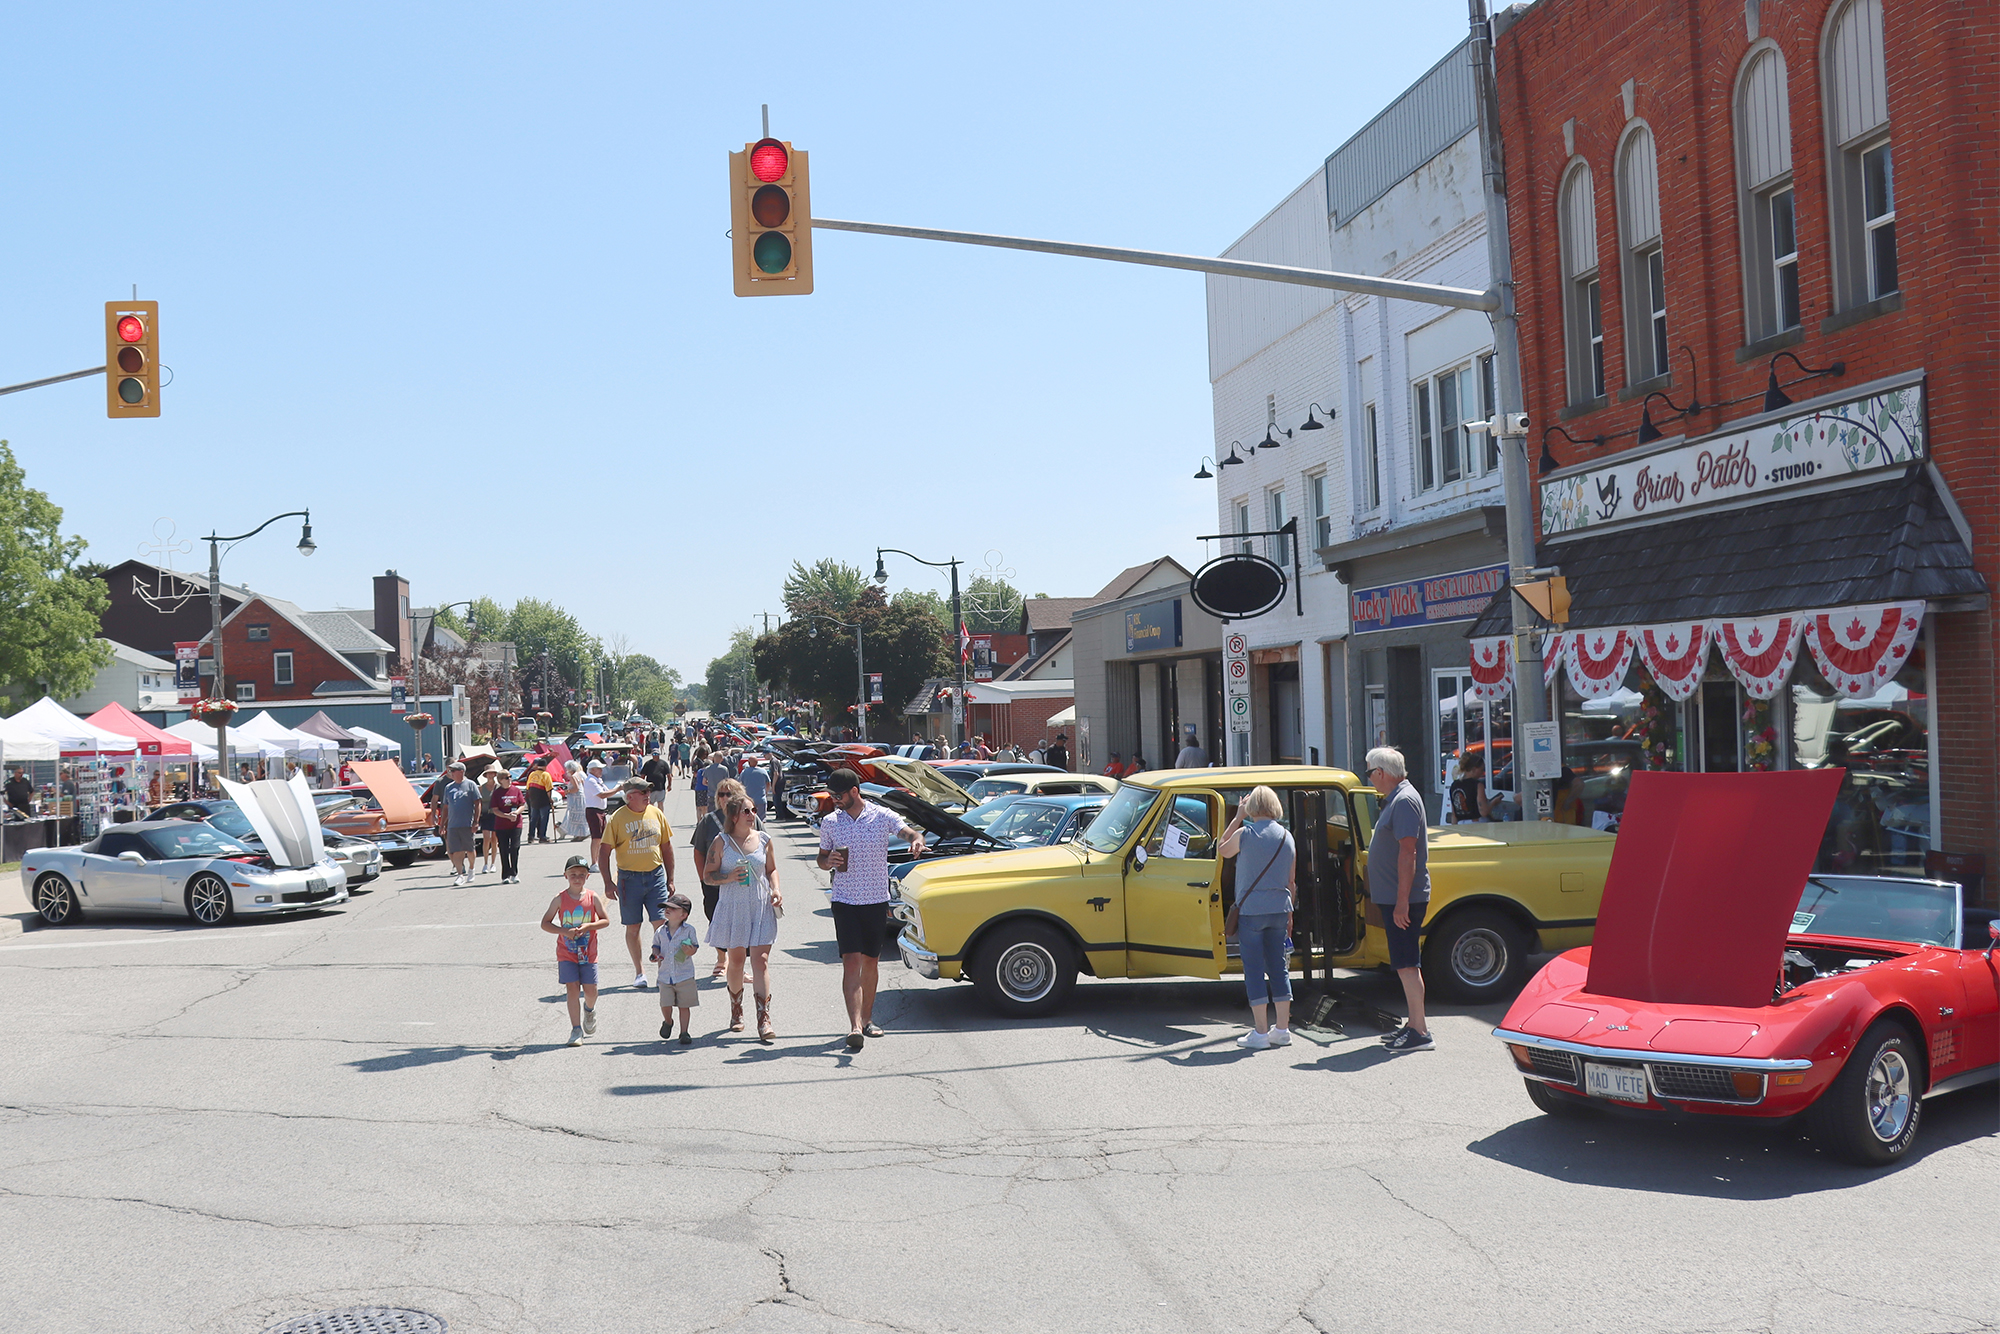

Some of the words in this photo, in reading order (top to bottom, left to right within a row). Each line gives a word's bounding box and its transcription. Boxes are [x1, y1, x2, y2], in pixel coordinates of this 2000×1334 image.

[1633, 465, 1684, 511] Briar
[1691, 440, 1756, 496] Patch
[1771, 460, 1815, 483] STUDIO
[1351, 590, 1389, 625] Lucky
[1388, 585, 1420, 617] Wok
[1424, 569, 1500, 602] RESTAURANT
[1588, 1070, 1609, 1089] MAD
[1615, 1074, 1644, 1095] VETE
